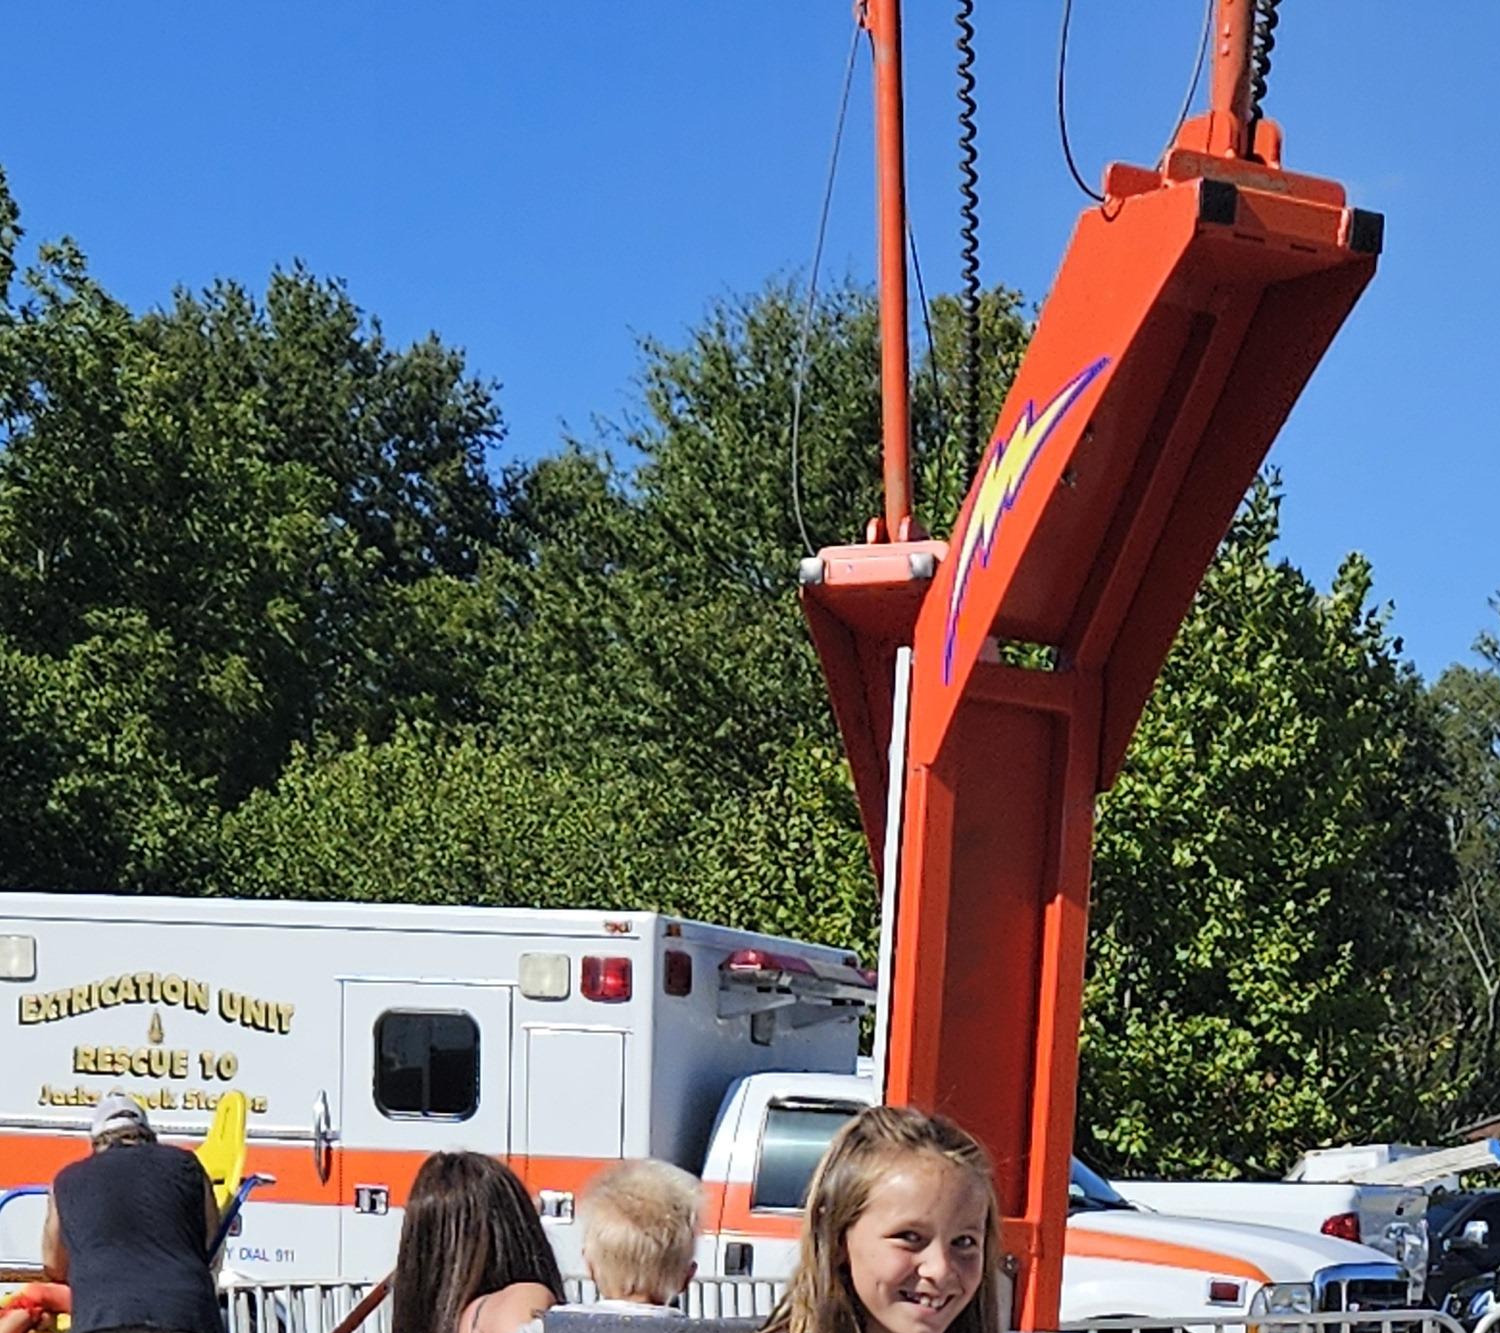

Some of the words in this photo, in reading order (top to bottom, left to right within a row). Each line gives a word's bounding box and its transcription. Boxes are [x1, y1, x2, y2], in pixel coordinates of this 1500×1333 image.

[19, 972, 209, 1025] EXTRICATION
[218, 988, 296, 1034] UNIT
[73, 1046, 188, 1079] RESCUE
